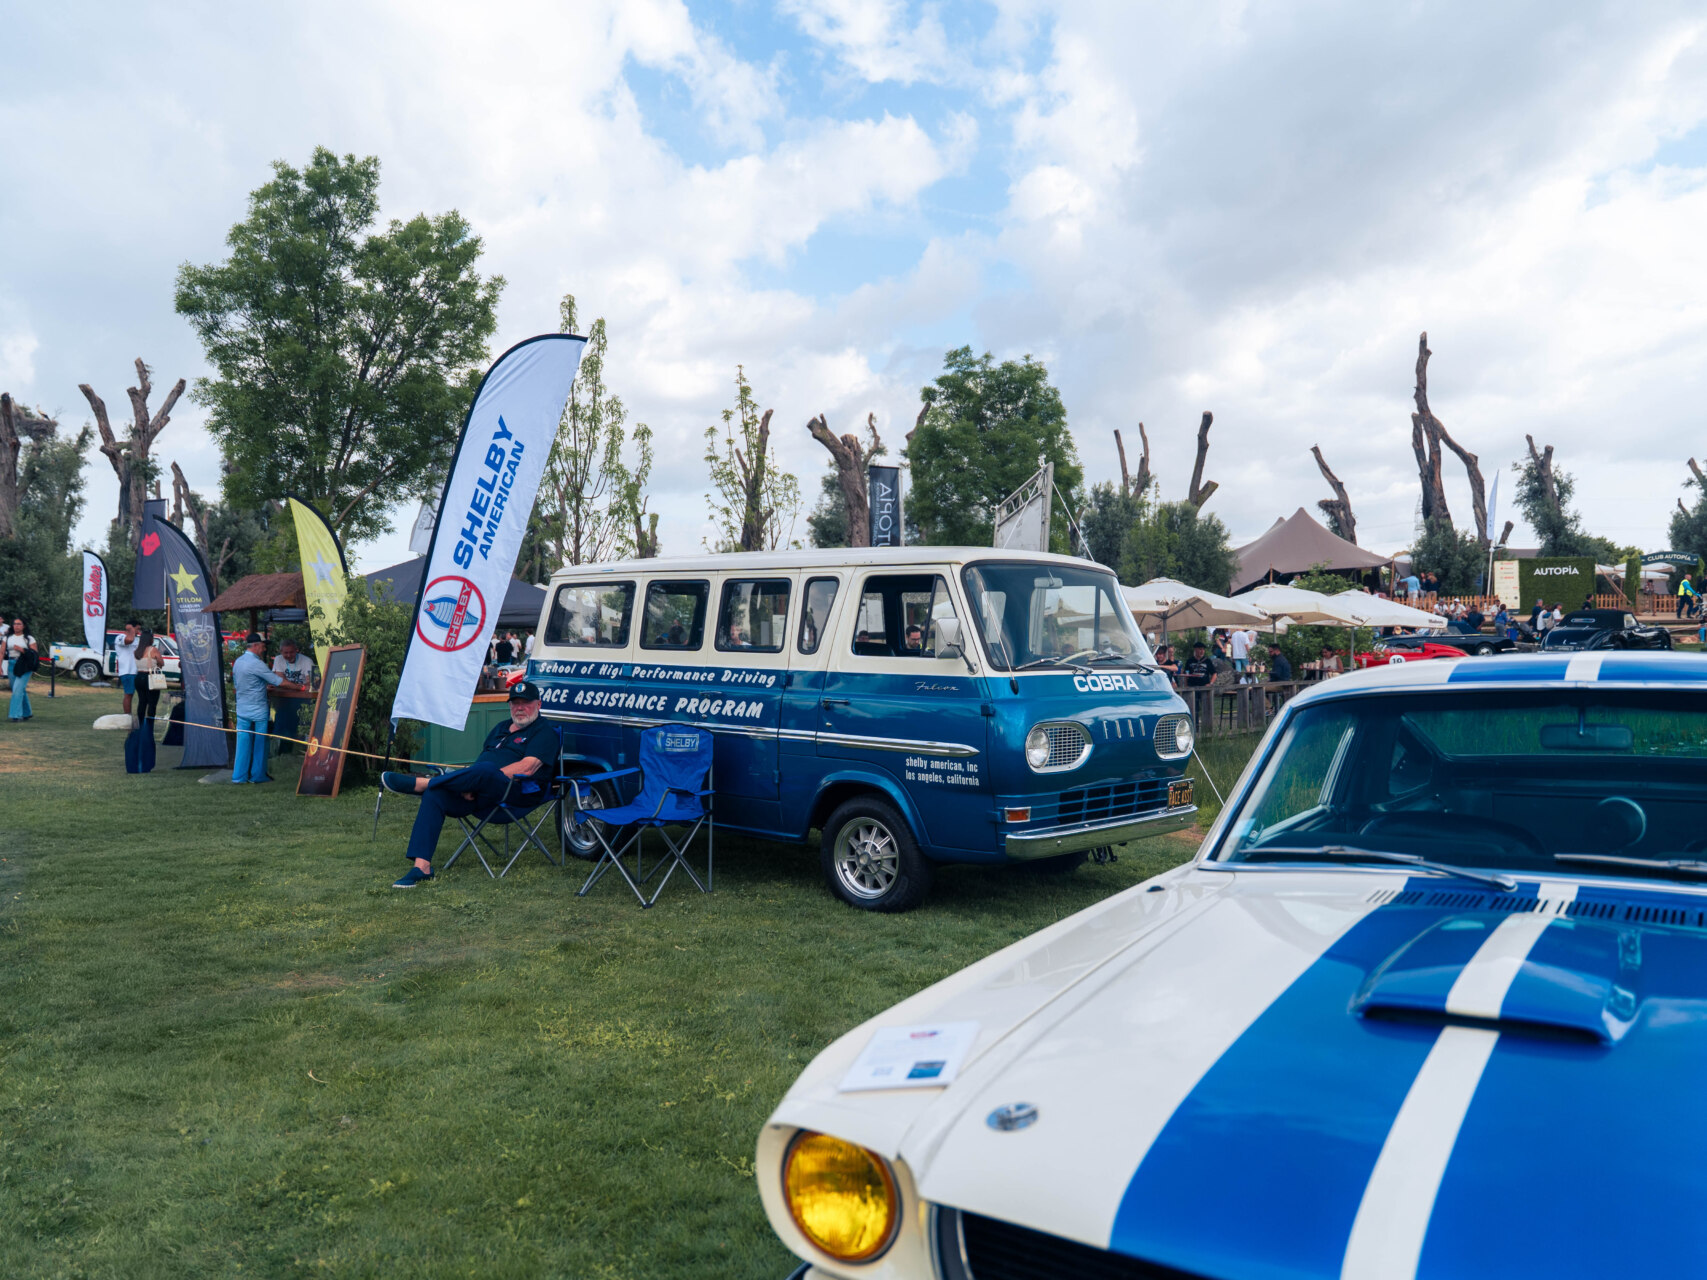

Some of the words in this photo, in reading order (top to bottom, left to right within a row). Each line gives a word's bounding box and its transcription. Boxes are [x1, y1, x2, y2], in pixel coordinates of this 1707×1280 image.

[453, 414, 514, 570] SHELBY
[478, 440, 525, 561] AMERICAN
[1647, 554, 1664, 562] CLUB
[447, 582, 471, 649] SHELBY
[540, 662, 577, 674] School
[581, 663, 595, 675] of
[632, 666, 716, 682] Performance
[721, 669, 776, 688] Driving
[1073, 675, 1140, 692] COBRA
[914, 681, 960, 691] Falcon
[574, 689, 668, 711] ASSISTANCE
[674, 697, 764, 719] PROGRAM
[665, 737, 696, 748] SHELBY
[905, 756, 928, 770] shelby
[930, 759, 965, 772] american,
[966, 761, 978, 773] inc
[905, 769, 916, 780] los
[917, 772, 945, 784] angeles,
[946, 774, 980, 786] california
